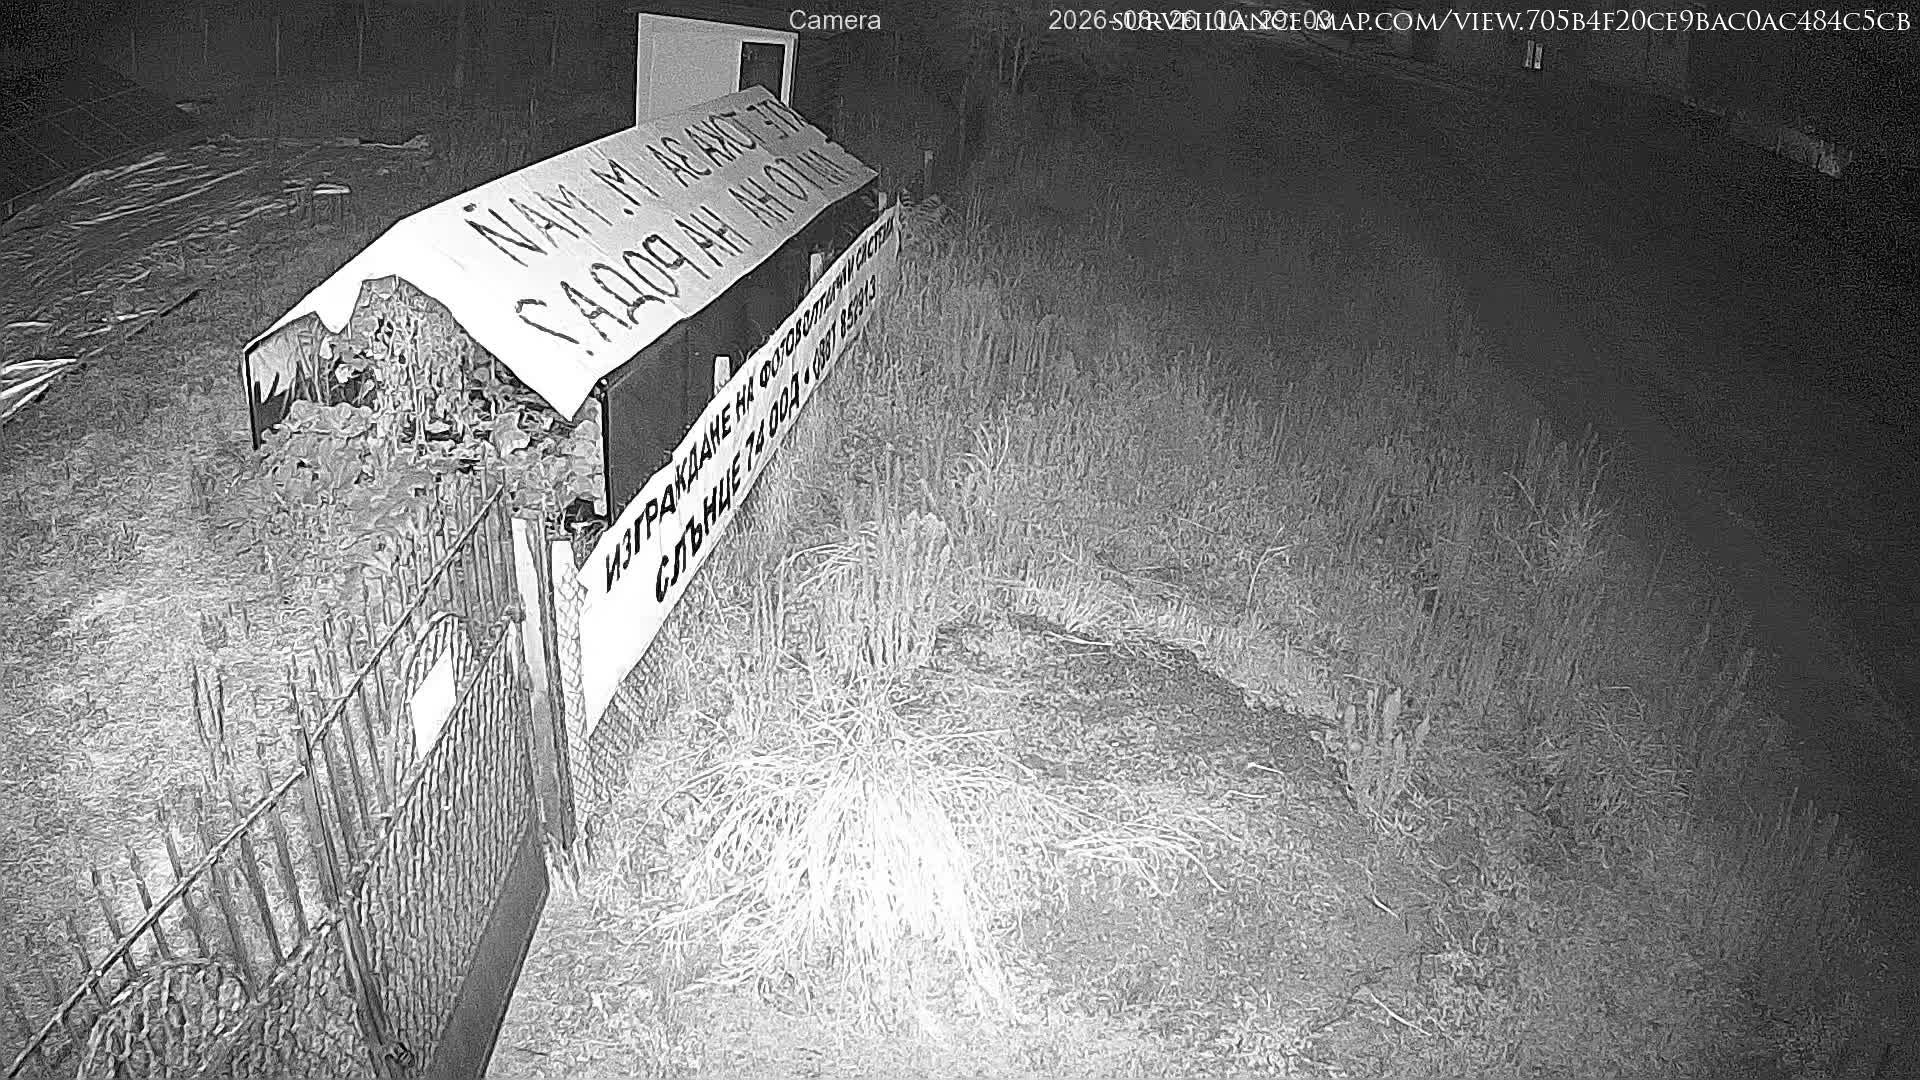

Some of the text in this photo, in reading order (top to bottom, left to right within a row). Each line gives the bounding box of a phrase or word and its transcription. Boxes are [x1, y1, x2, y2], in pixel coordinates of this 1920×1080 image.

[605, 401, 732, 594] ИЗГРАЖДАНЕ
[735, 376, 755, 425] НА
[655, 454, 741, 603] СЛЪНЦЕ
[744, 417, 765, 472] 74
[768, 373, 801, 439] ООД
